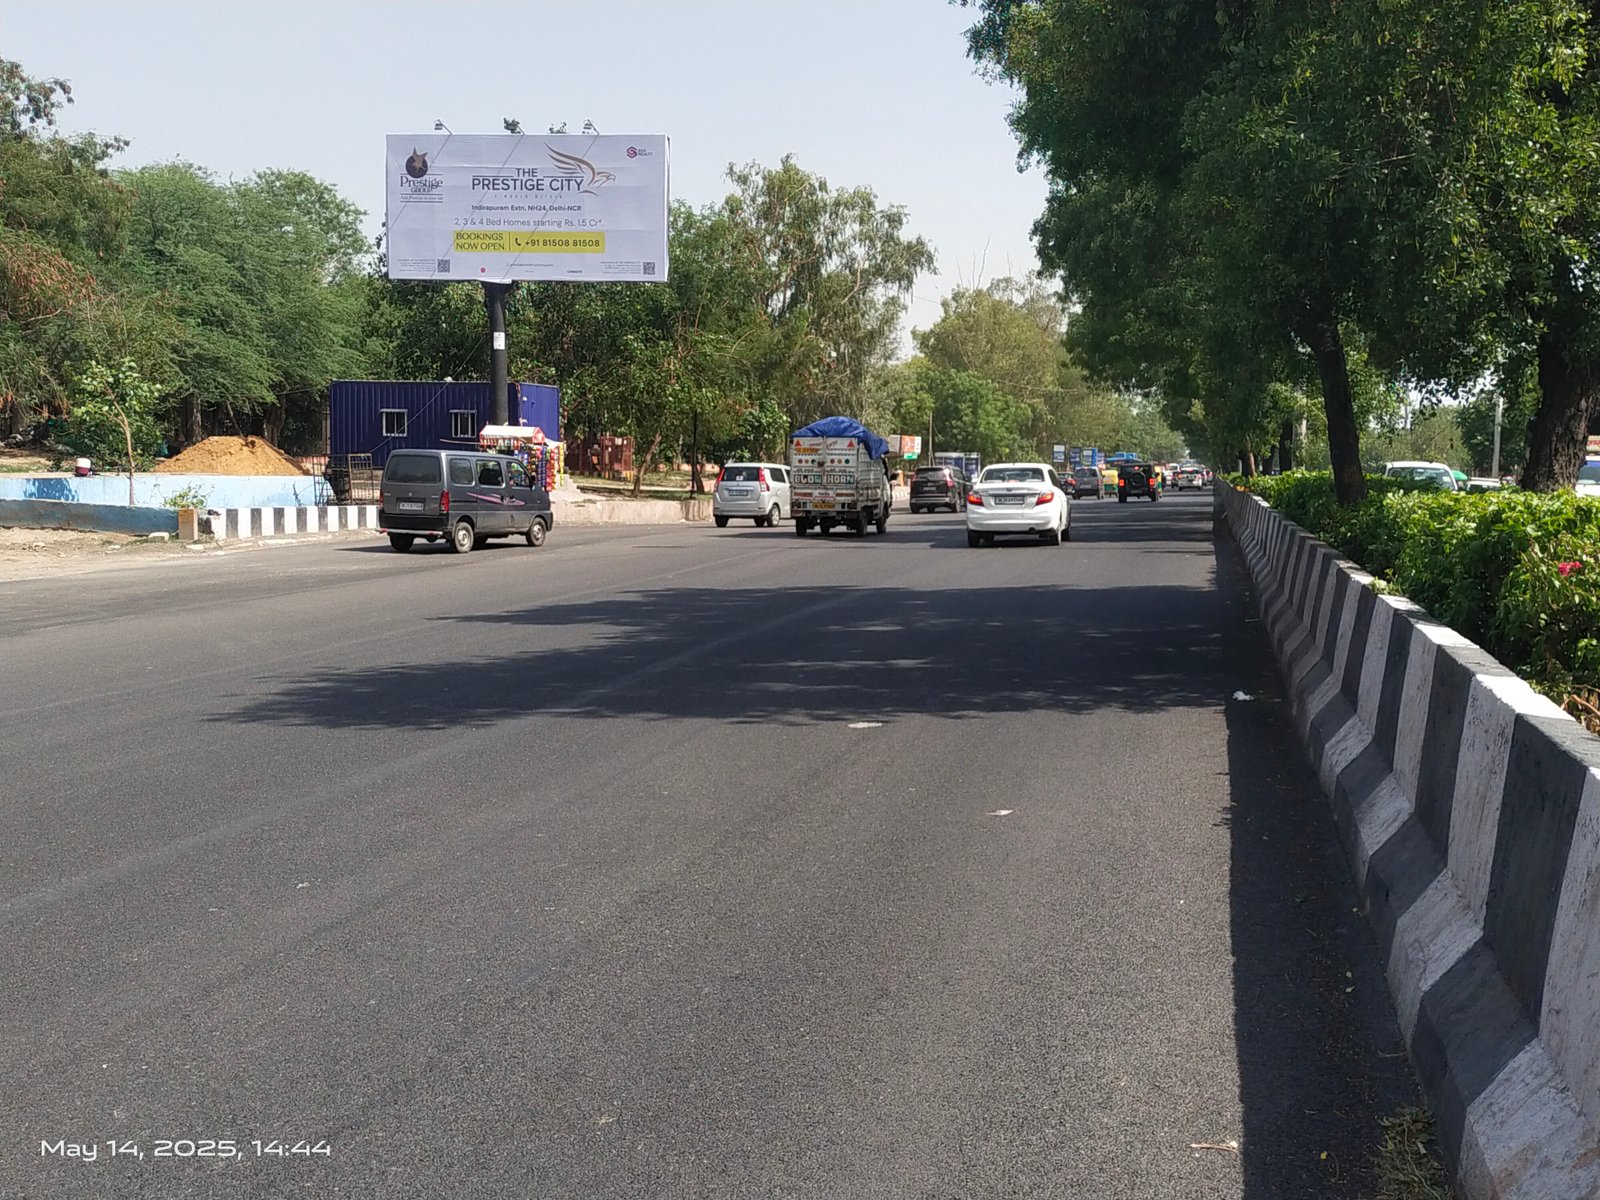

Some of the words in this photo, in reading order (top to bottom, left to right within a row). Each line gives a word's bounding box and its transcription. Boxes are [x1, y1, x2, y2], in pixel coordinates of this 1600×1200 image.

[515, 168, 538, 177] THE
[400, 175, 443, 191] Prestige
[471, 178, 544, 191] PRESTIGE
[549, 178, 584, 191] CITY
[471, 204, 509, 212] Indirapuram
[463, 217, 468, 226] 3
[470, 217, 476, 226] &
[478, 217, 484, 226] 4
[485, 217, 501, 226] Bed
[503, 218, 530, 227] Homes
[532, 218, 562, 229] starting
[456, 232, 504, 241] BOOKINGS
[456, 242, 479, 250] NOW
[525, 238, 540, 247] +91
[542, 238, 570, 247] 81508
[572, 239, 600, 248] 81508
[826, 474, 855, 484] HORN
